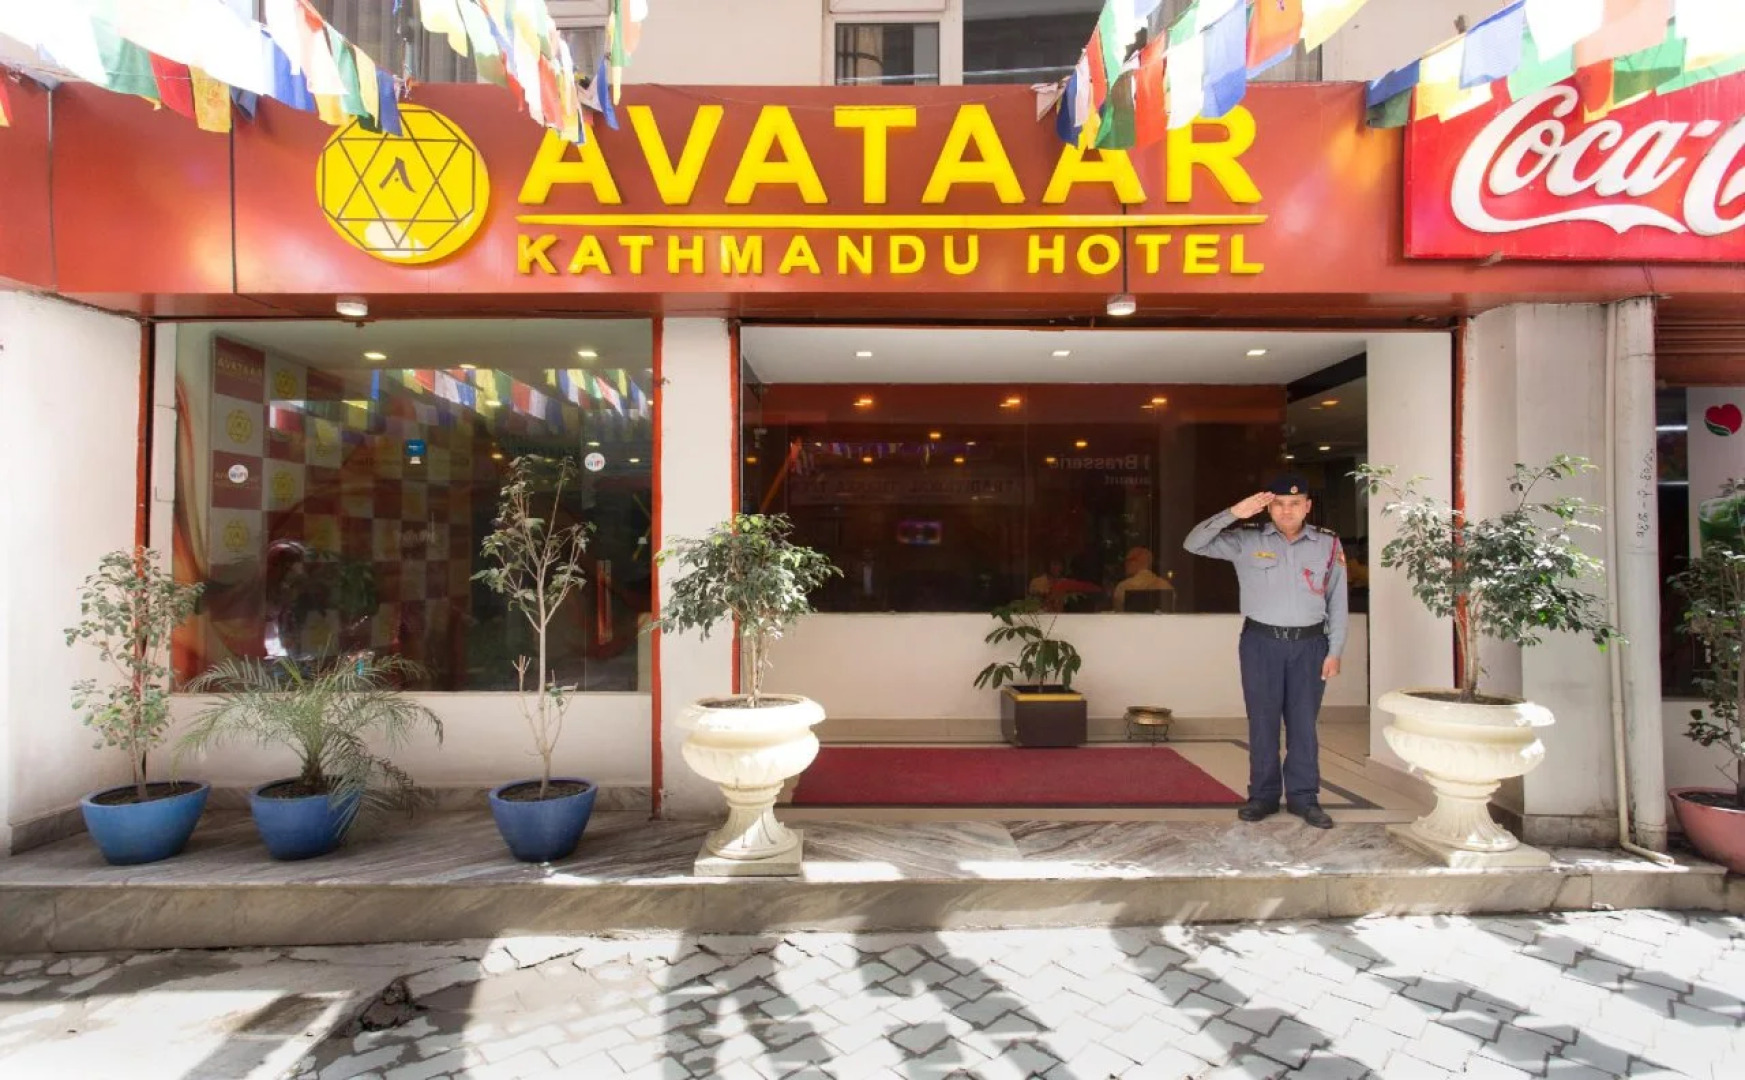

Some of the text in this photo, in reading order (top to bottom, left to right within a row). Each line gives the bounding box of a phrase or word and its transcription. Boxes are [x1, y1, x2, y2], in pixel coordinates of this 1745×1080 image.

[518, 105, 1264, 205] AVATAAR
[1451, 84, 1745, 236] Coca-C
[517, 233, 1265, 276] KATHMANDU HOTEL
